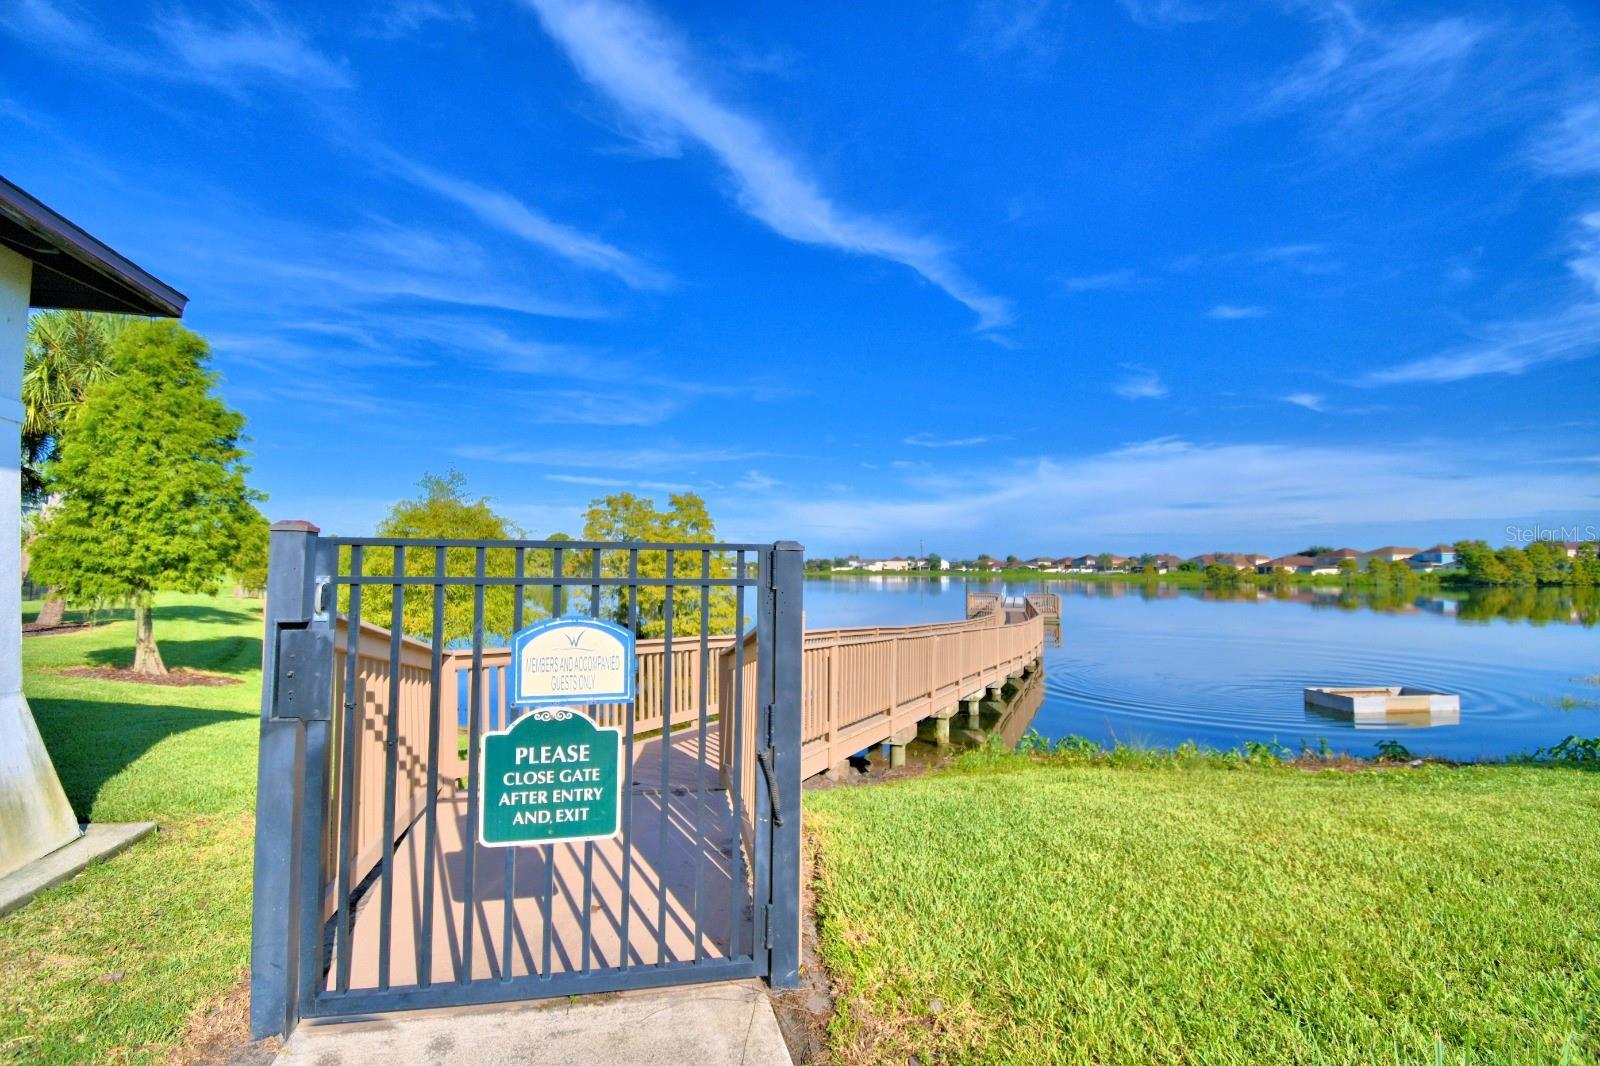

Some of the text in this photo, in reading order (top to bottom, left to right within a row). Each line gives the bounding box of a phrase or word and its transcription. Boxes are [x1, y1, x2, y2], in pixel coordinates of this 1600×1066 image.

[526, 655, 620, 673] MEMBERS AND ACCOMPANIED
[551, 674, 596, 691] GUESTS ONLY
[515, 744, 590, 765] PLEASE
[503, 768, 601, 786] CLOSE GATE
[498, 787, 604, 807] AFTER ENTRY
[555, 807, 590, 823] EXIT
